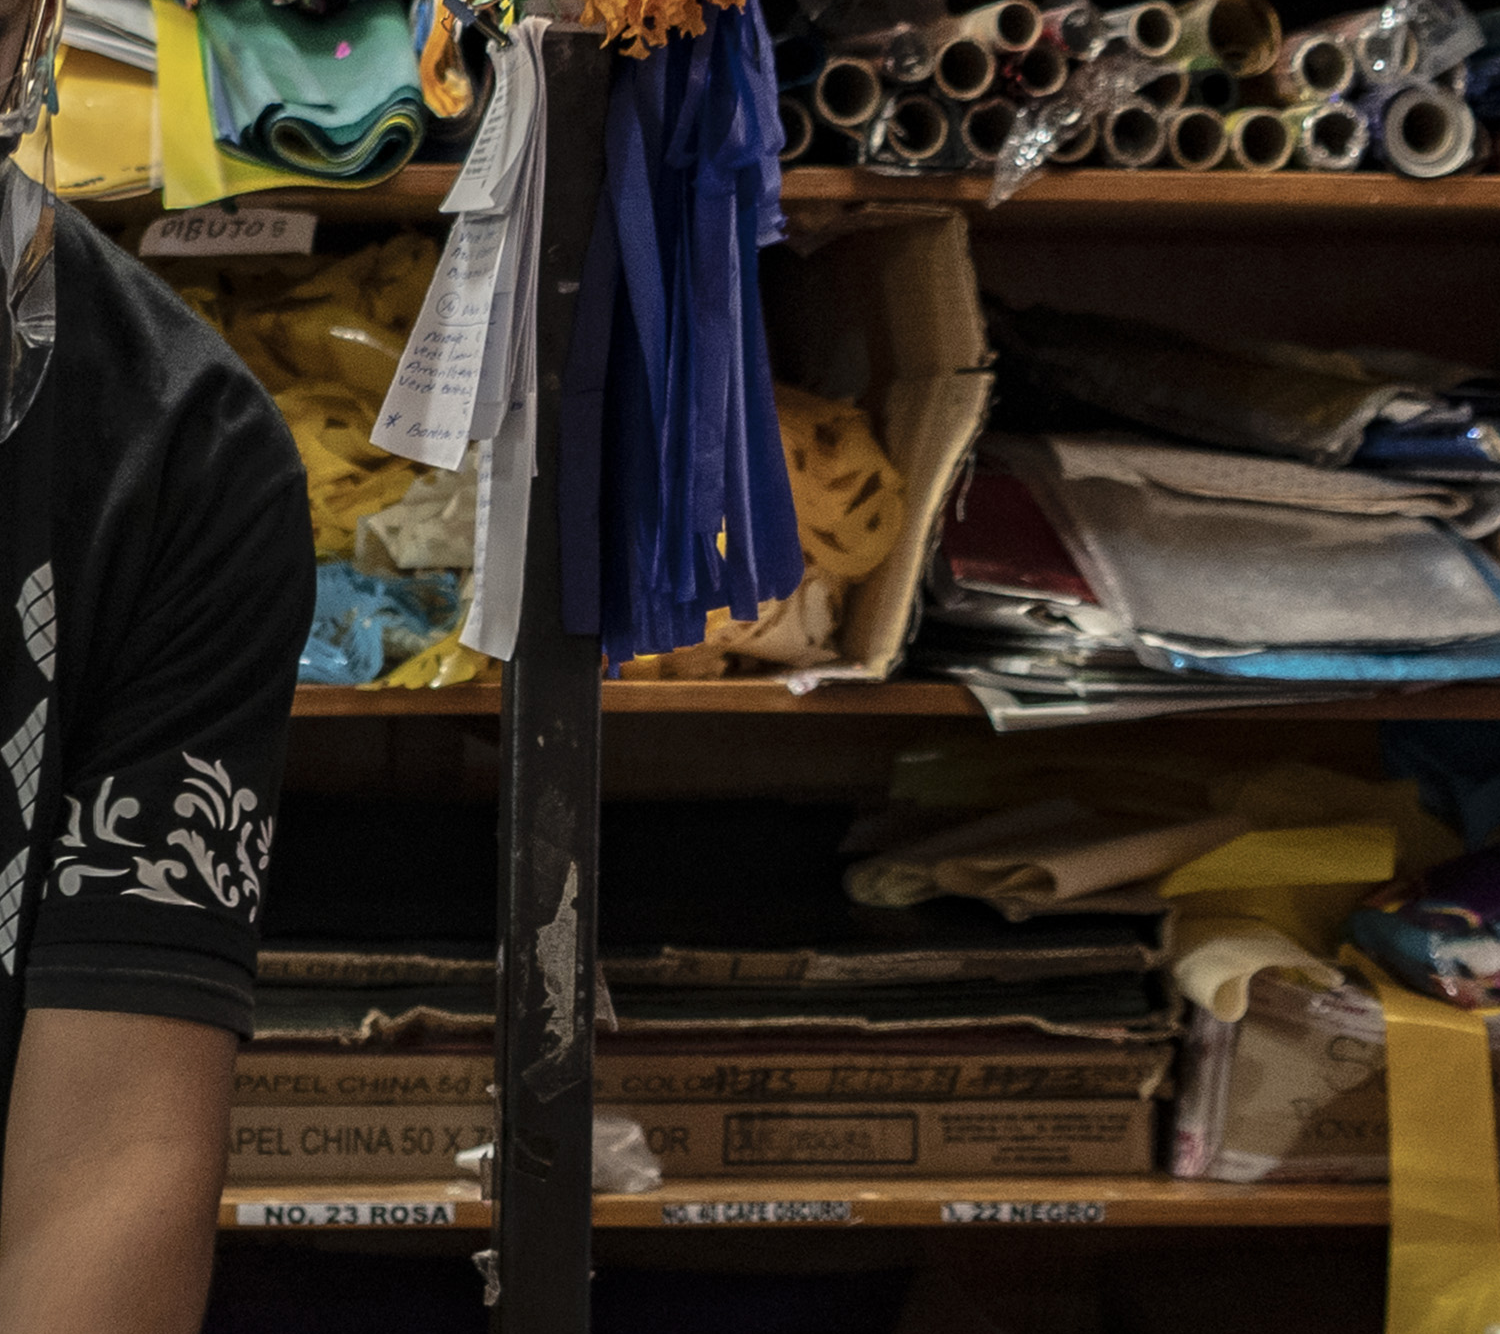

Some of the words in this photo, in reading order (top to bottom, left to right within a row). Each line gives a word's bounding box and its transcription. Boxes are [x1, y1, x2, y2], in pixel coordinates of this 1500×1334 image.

[234, 1073, 328, 1095] PAPEL
[336, 1075, 430, 1095] CHINA
[300, 1125, 396, 1156] CHINA
[400, 1125, 435, 1156] 50
[438, 1126, 464, 1155] X
[264, 1206, 317, 1225] NO.
[325, 1206, 358, 1225] 23
[368, 1206, 449, 1225] ROSA
[971, 1203, 1001, 1222] 22
[1008, 1202, 1099, 1222] NEGRO
